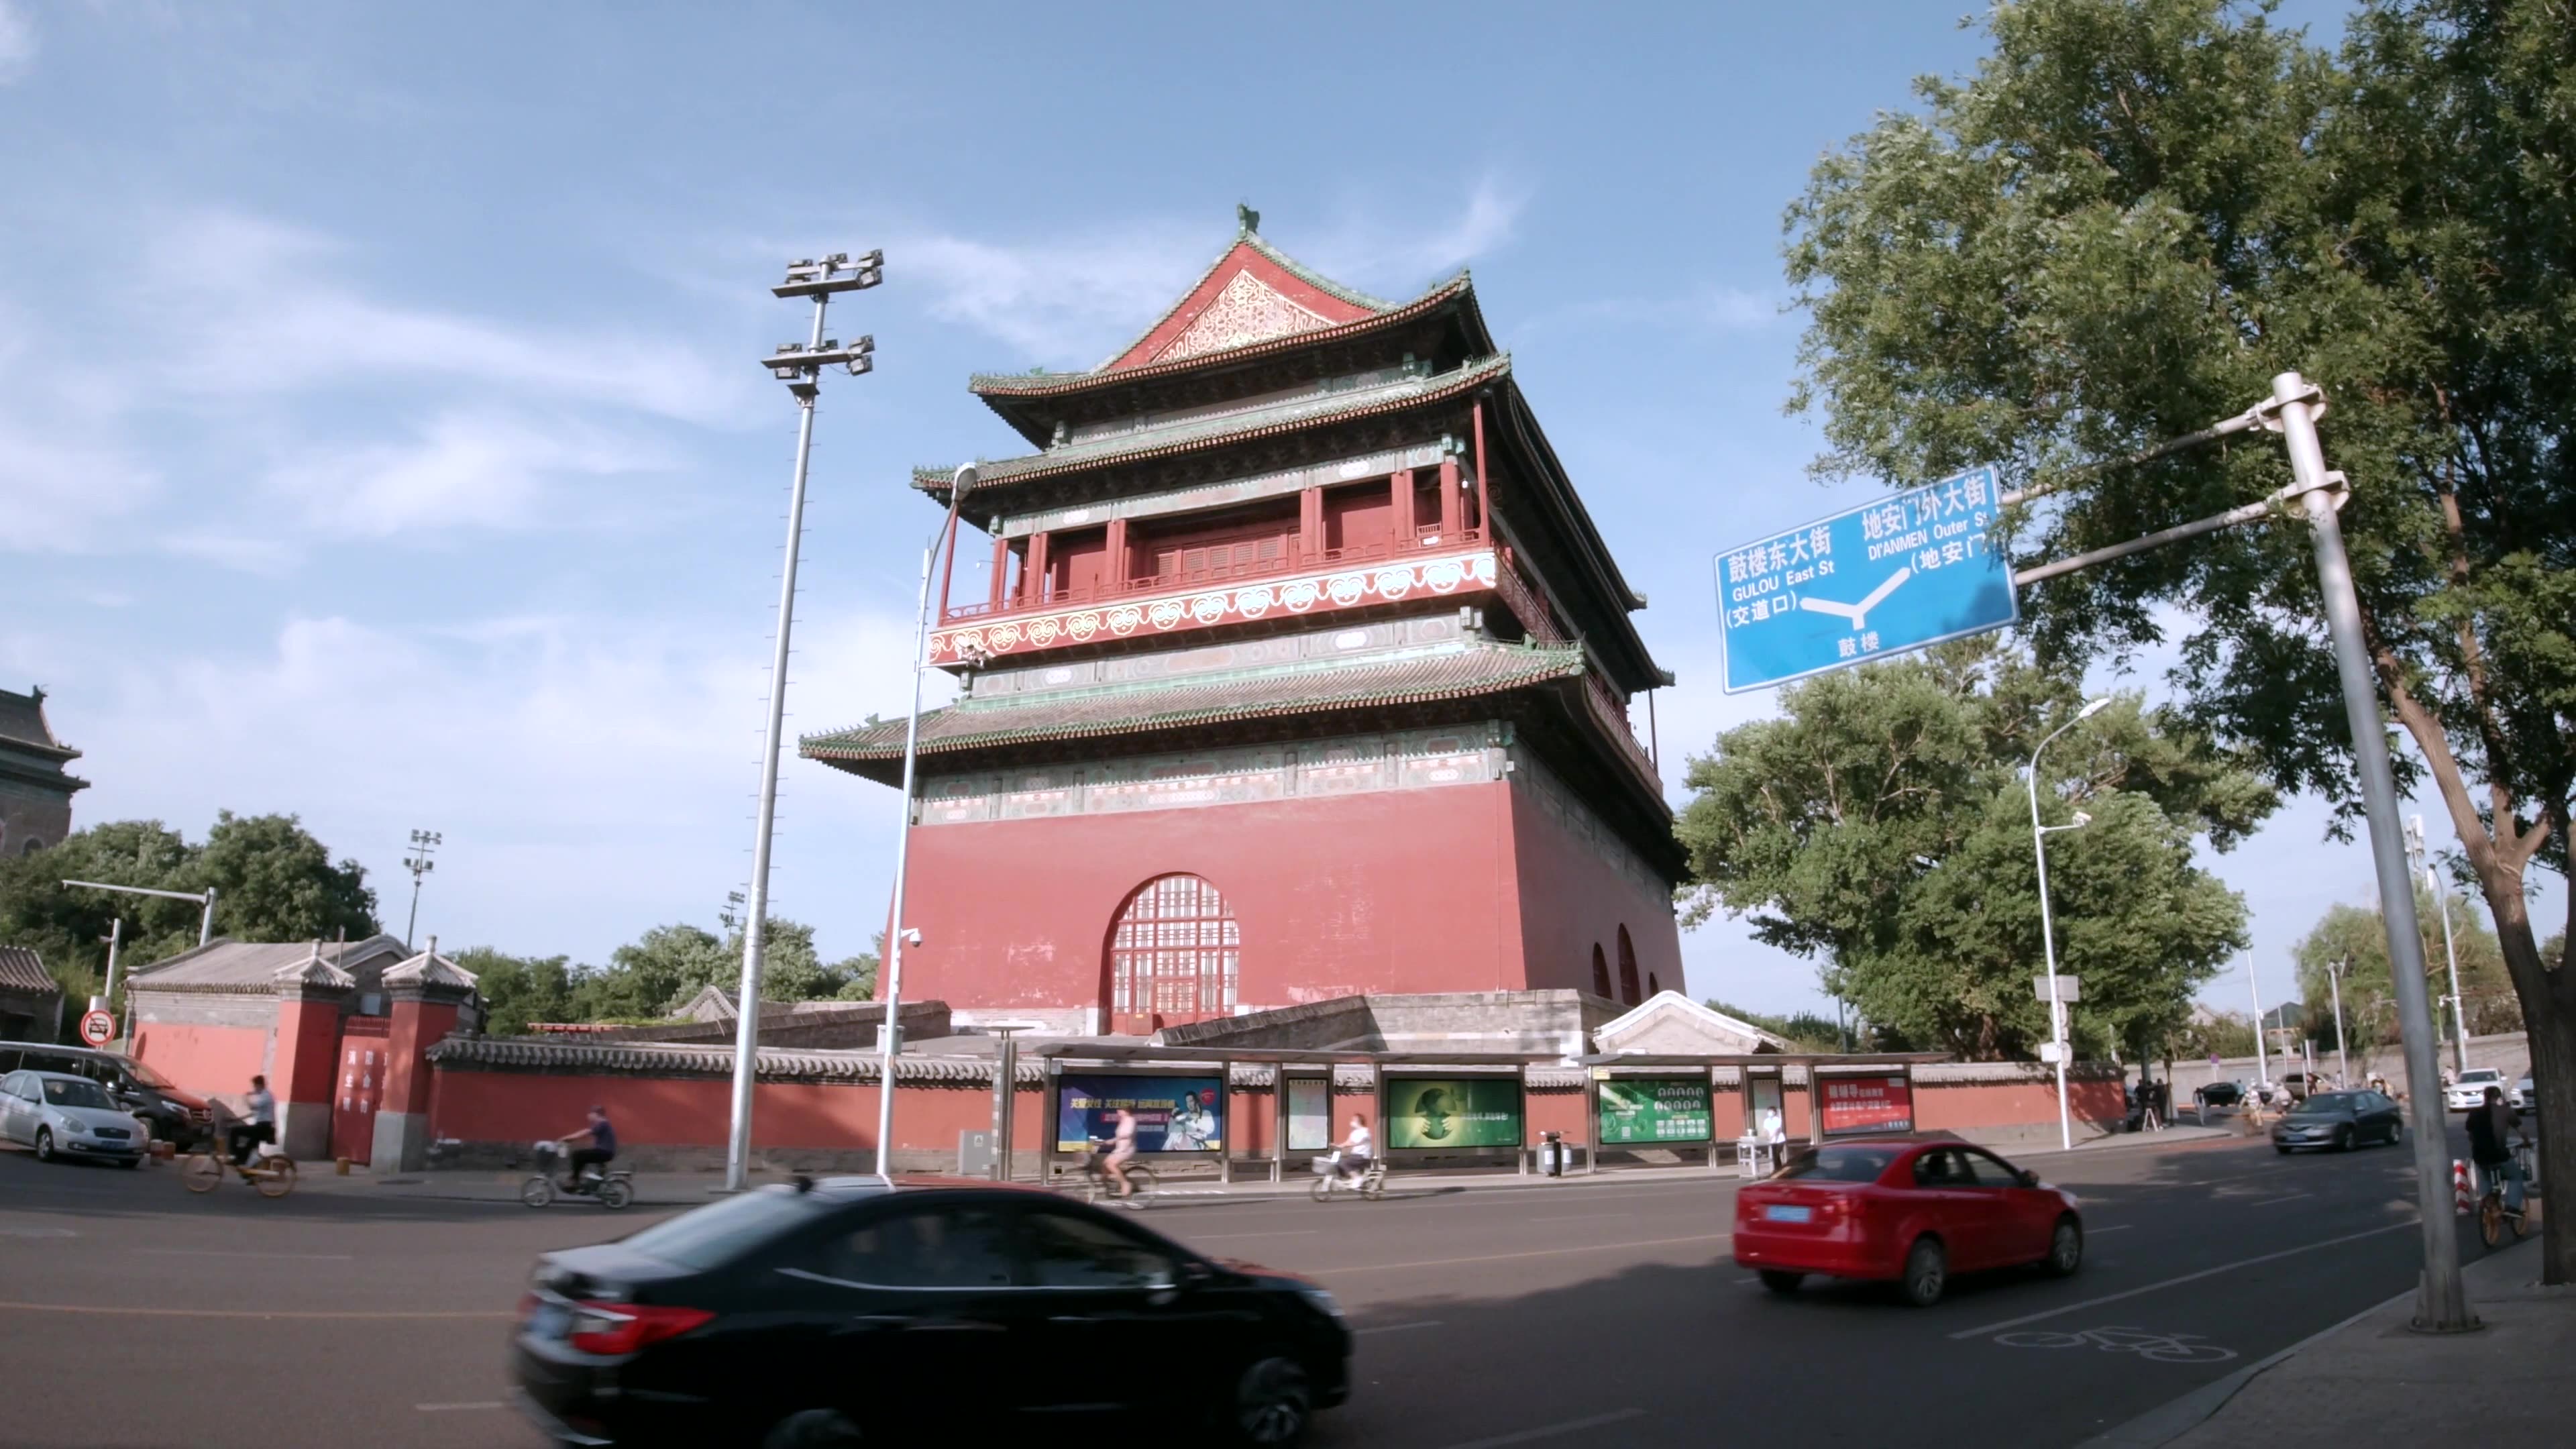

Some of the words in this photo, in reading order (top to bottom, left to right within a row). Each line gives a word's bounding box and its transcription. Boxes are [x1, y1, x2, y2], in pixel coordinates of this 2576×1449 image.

[1862, 475, 1987, 541] 地安门外大街
[1727, 525, 1831, 584] 鼓楼东大街
[1868, 529, 1928, 561] DI'ANMEN
[1933, 518, 1968, 539] Outer
[1732, 575, 1779, 602] GULOU
[1786, 566, 1815, 586] East
[1819, 559, 1835, 576] St
[1725, 590, 1796, 629] (交道口)
[1837, 631, 1880, 658] 鼓楼
